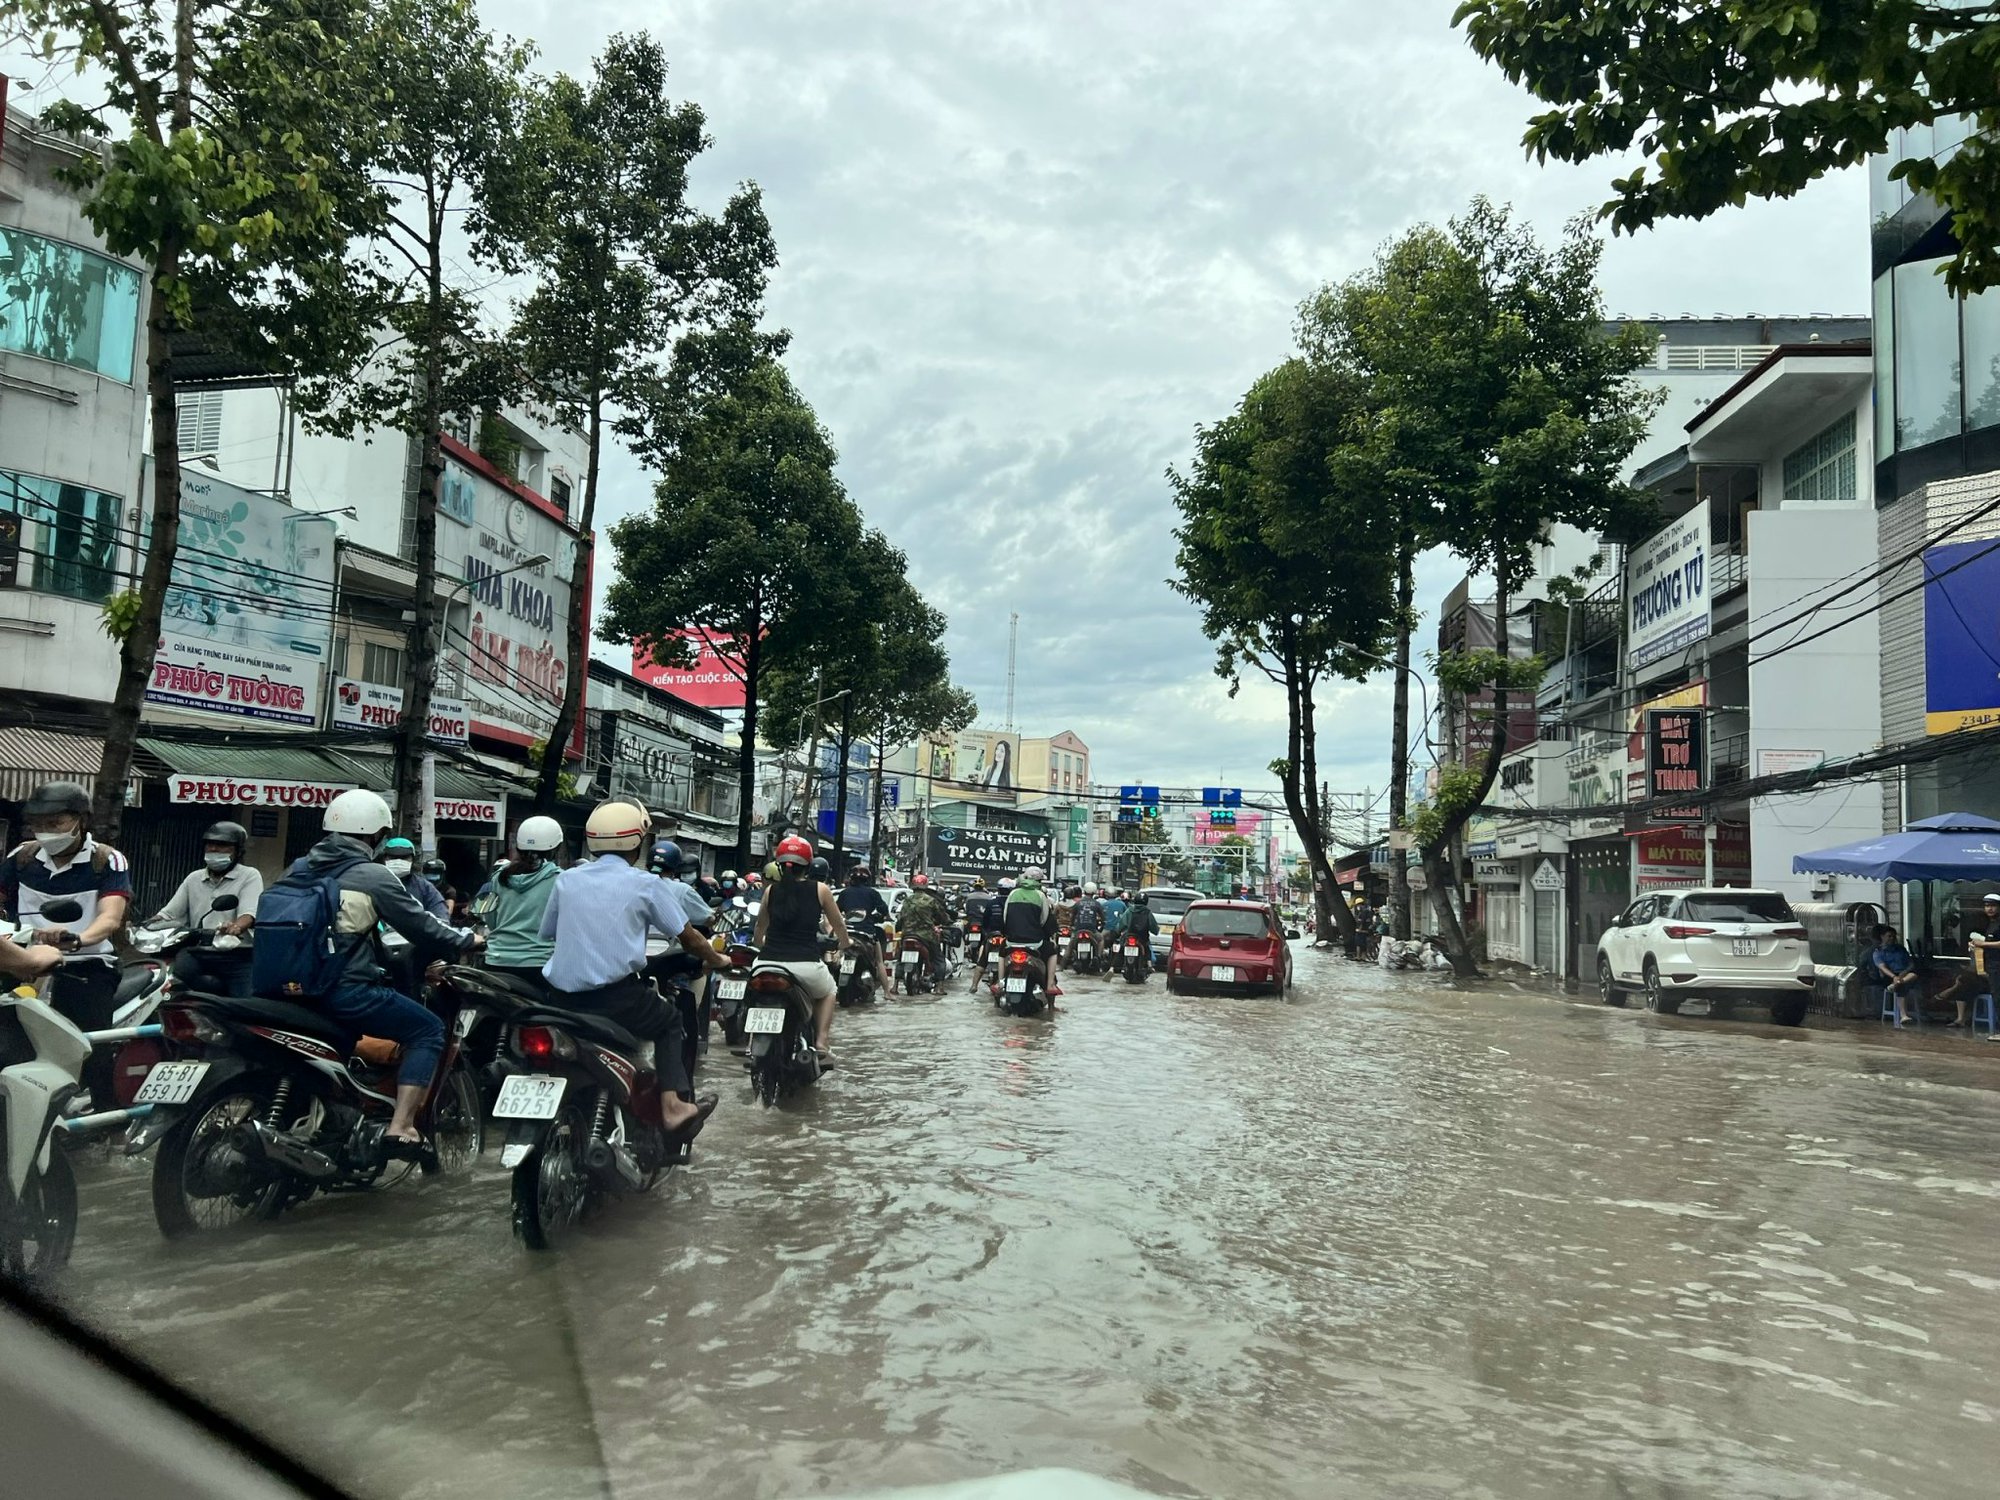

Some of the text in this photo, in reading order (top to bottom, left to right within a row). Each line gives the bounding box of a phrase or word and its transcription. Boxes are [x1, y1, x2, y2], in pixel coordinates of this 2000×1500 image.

[1649, 521, 1685, 553] CÔNG TY TNHH
[464, 555, 554, 633] NHA KHOA
[1632, 568, 1682, 634] PHƯƠNG
[1684, 545, 1705, 602] VŨ
[153, 662, 223, 697] PHÚC
[653, 672, 673, 685] KIẾN
[676, 675, 692, 685] TẠO
[695, 672, 720, 684] CUỘC
[1660, 715, 1690, 739] MÁY
[1662, 741, 1690, 768] TRỢ
[1655, 766, 1698, 790] THÍNH
[177, 779, 257, 803] PHÚC
[434, 800, 496, 819] TƯỜNG
[997, 830, 1032, 845] Kính
[1013, 850, 1047, 864] THƠ
[1648, 844, 1677, 859] MÁY
[1478, 865, 1517, 875] JUSTYLE
[753, 1010, 779, 1020] 84-K6
[750, 1021, 778, 1031] 7048
[600, 1053, 629, 1075] BLADE
[156, 1065, 198, 1083] 65-B1
[139, 1083, 193, 1100] 659.11
[511, 1080, 555, 1097] 65-B2
[500, 1097, 555, 1115] 667.51
